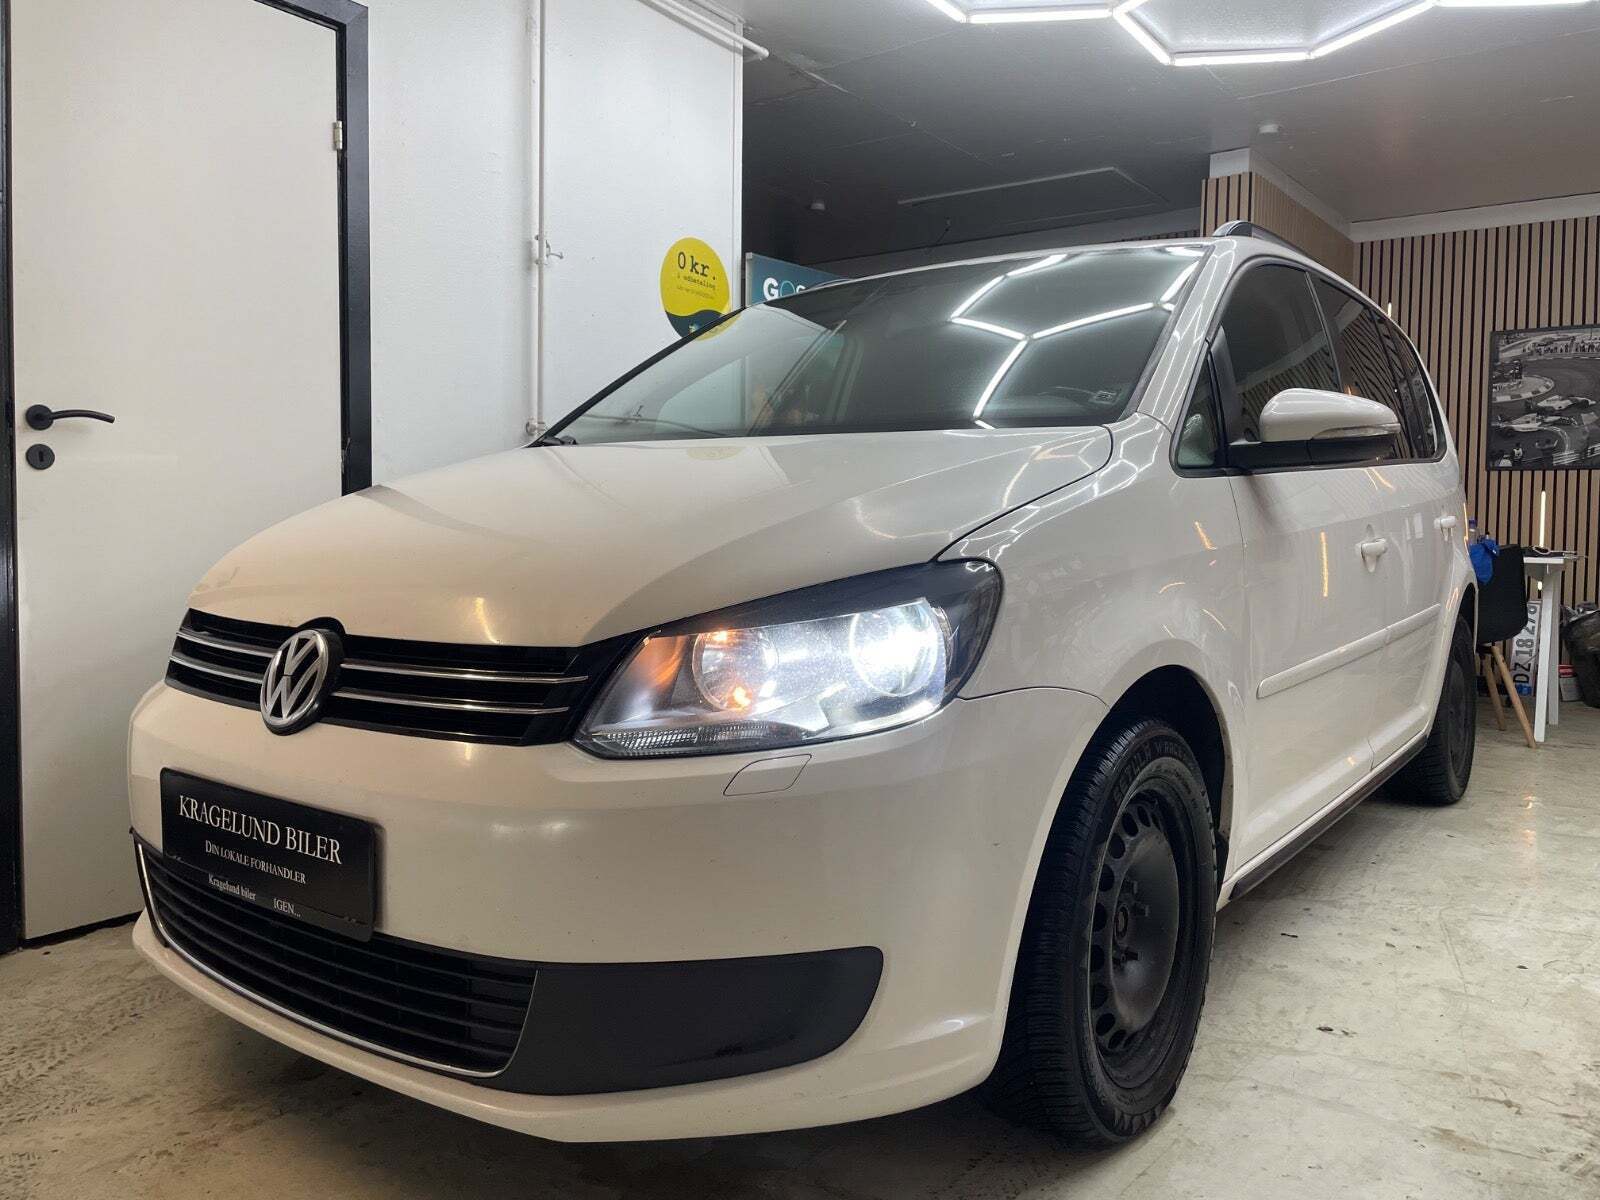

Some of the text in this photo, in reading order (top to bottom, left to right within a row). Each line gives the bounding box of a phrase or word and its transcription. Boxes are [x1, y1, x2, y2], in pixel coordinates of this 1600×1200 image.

[178, 795, 342, 865] KRAGELUND BILER
[205, 840, 307, 884] DIN LOKALE FORHANDLER
[208, 874, 240, 896] Kragelund
[240, 884, 257, 901] biler
